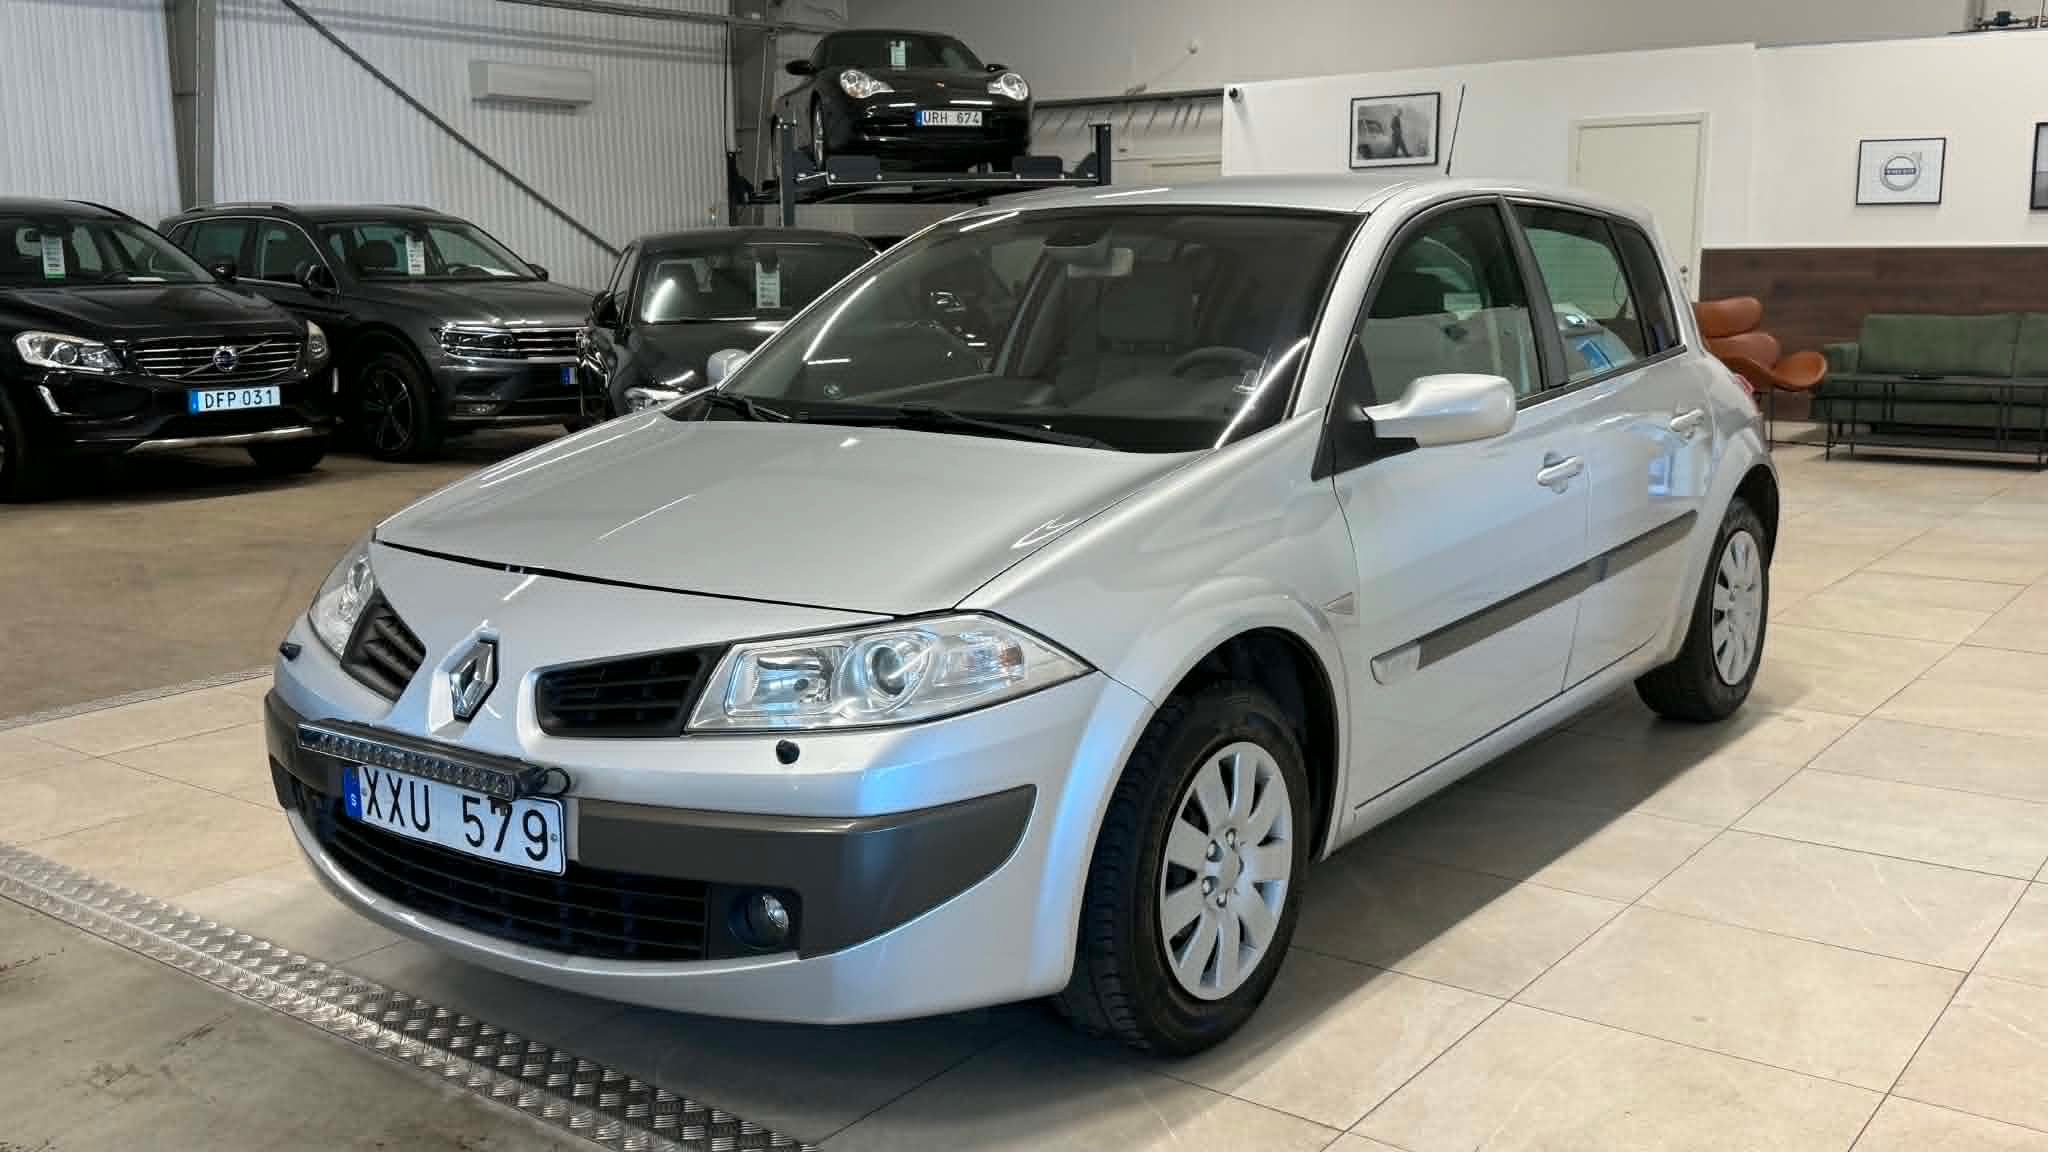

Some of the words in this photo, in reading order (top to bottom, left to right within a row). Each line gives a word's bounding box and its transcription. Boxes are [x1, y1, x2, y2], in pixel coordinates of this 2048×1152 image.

[923, 111, 948, 124] URH
[957, 111, 980, 124] 674
[204, 391, 237, 409] DFP
[242, 389, 273, 406] 031
[363, 766, 432, 833] XXU
[461, 795, 549, 862] 579
